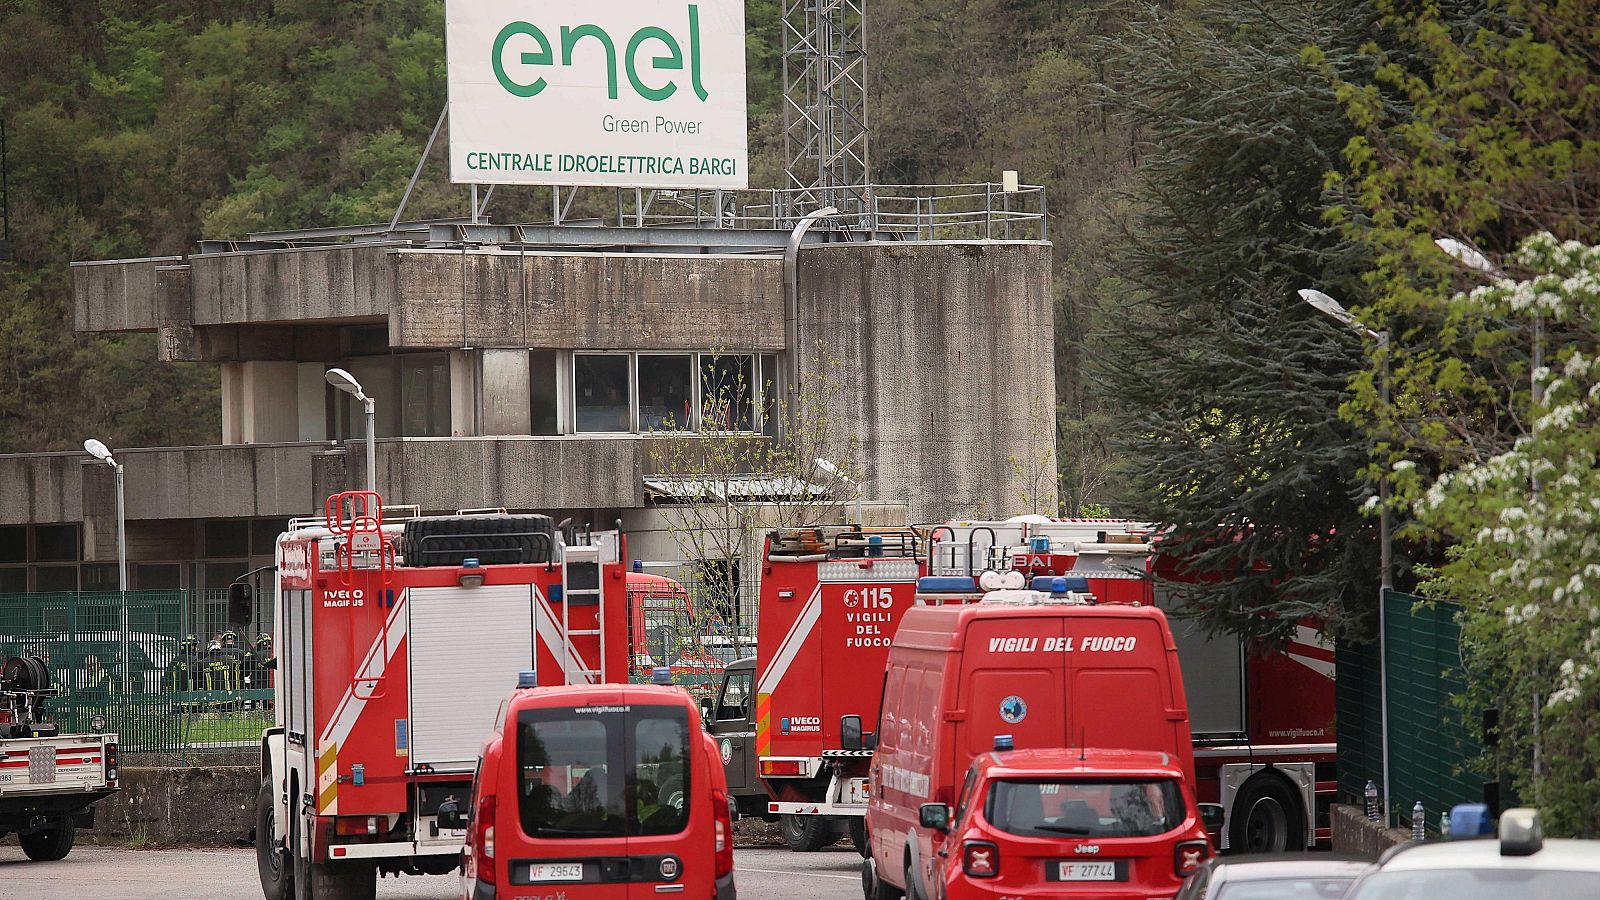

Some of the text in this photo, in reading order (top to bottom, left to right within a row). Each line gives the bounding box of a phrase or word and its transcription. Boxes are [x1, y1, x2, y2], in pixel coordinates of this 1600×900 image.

[491, 4, 709, 102] enel
[602, 114, 702, 134] Green Power
[466, 152, 736, 176] CENTRALE IDROELETTRICA BARGI
[1013, 555, 1052, 567] BAI
[861, 587, 893, 609] 115
[846, 612, 891, 622] VIGILI
[856, 625, 881, 635] DEL
[846, 637, 891, 647] FUOCO
[988, 636, 1137, 652] VIGILI DEL FUOCO
[791, 717, 820, 725] IVECO
[1073, 844, 1100, 855] Jeep
[532, 863, 582, 878] VF 29643
[1062, 865, 1113, 878] VF 27744
